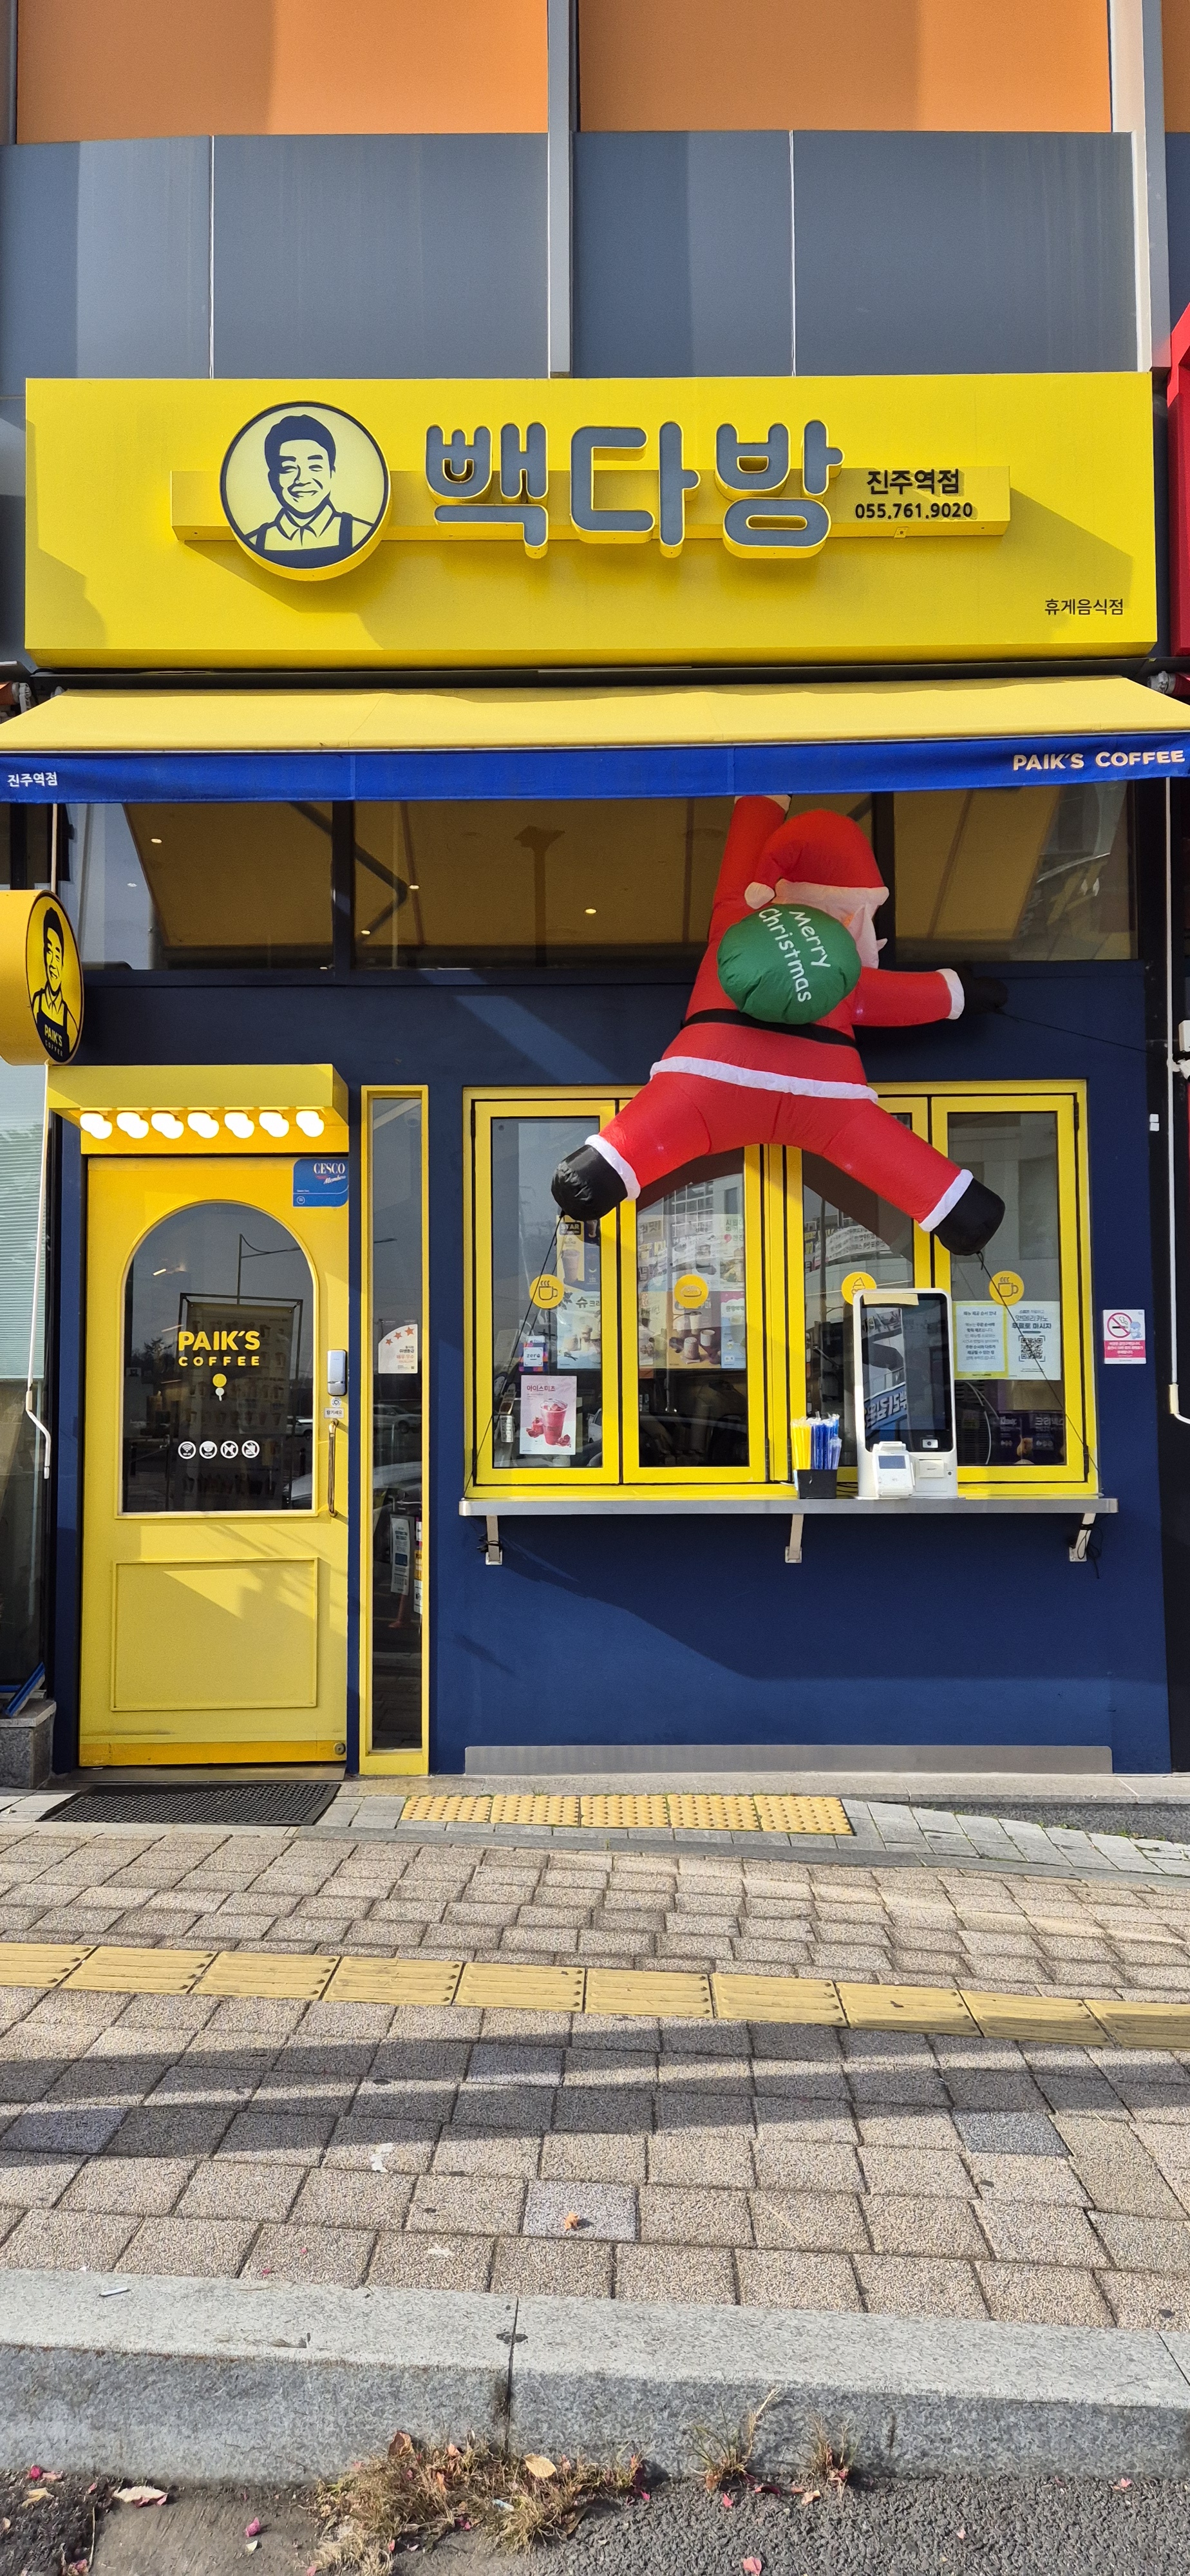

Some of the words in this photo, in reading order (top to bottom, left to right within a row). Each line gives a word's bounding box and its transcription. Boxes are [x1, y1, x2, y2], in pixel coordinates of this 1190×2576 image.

[426, 420, 845, 556] 빽다방
[867, 468, 960, 495] 진주역점
[855, 502, 973, 520] 055.761.9020
[1044, 598, 1125, 616] 휴게음식점
[1012, 753, 1084, 772] PAIK'S
[1095, 749, 1185, 768] COFFEE
[7, 772, 57, 787] 진주역점
[789, 911, 831, 969] Merry
[759, 907, 811, 1003] Christmas
[44, 1024, 62, 1047] PAIK'S
[313, 1162, 346, 1175] CESCO
[178, 1331, 261, 1351] PAIK'S
[178, 1356, 260, 1367] COFFEE
